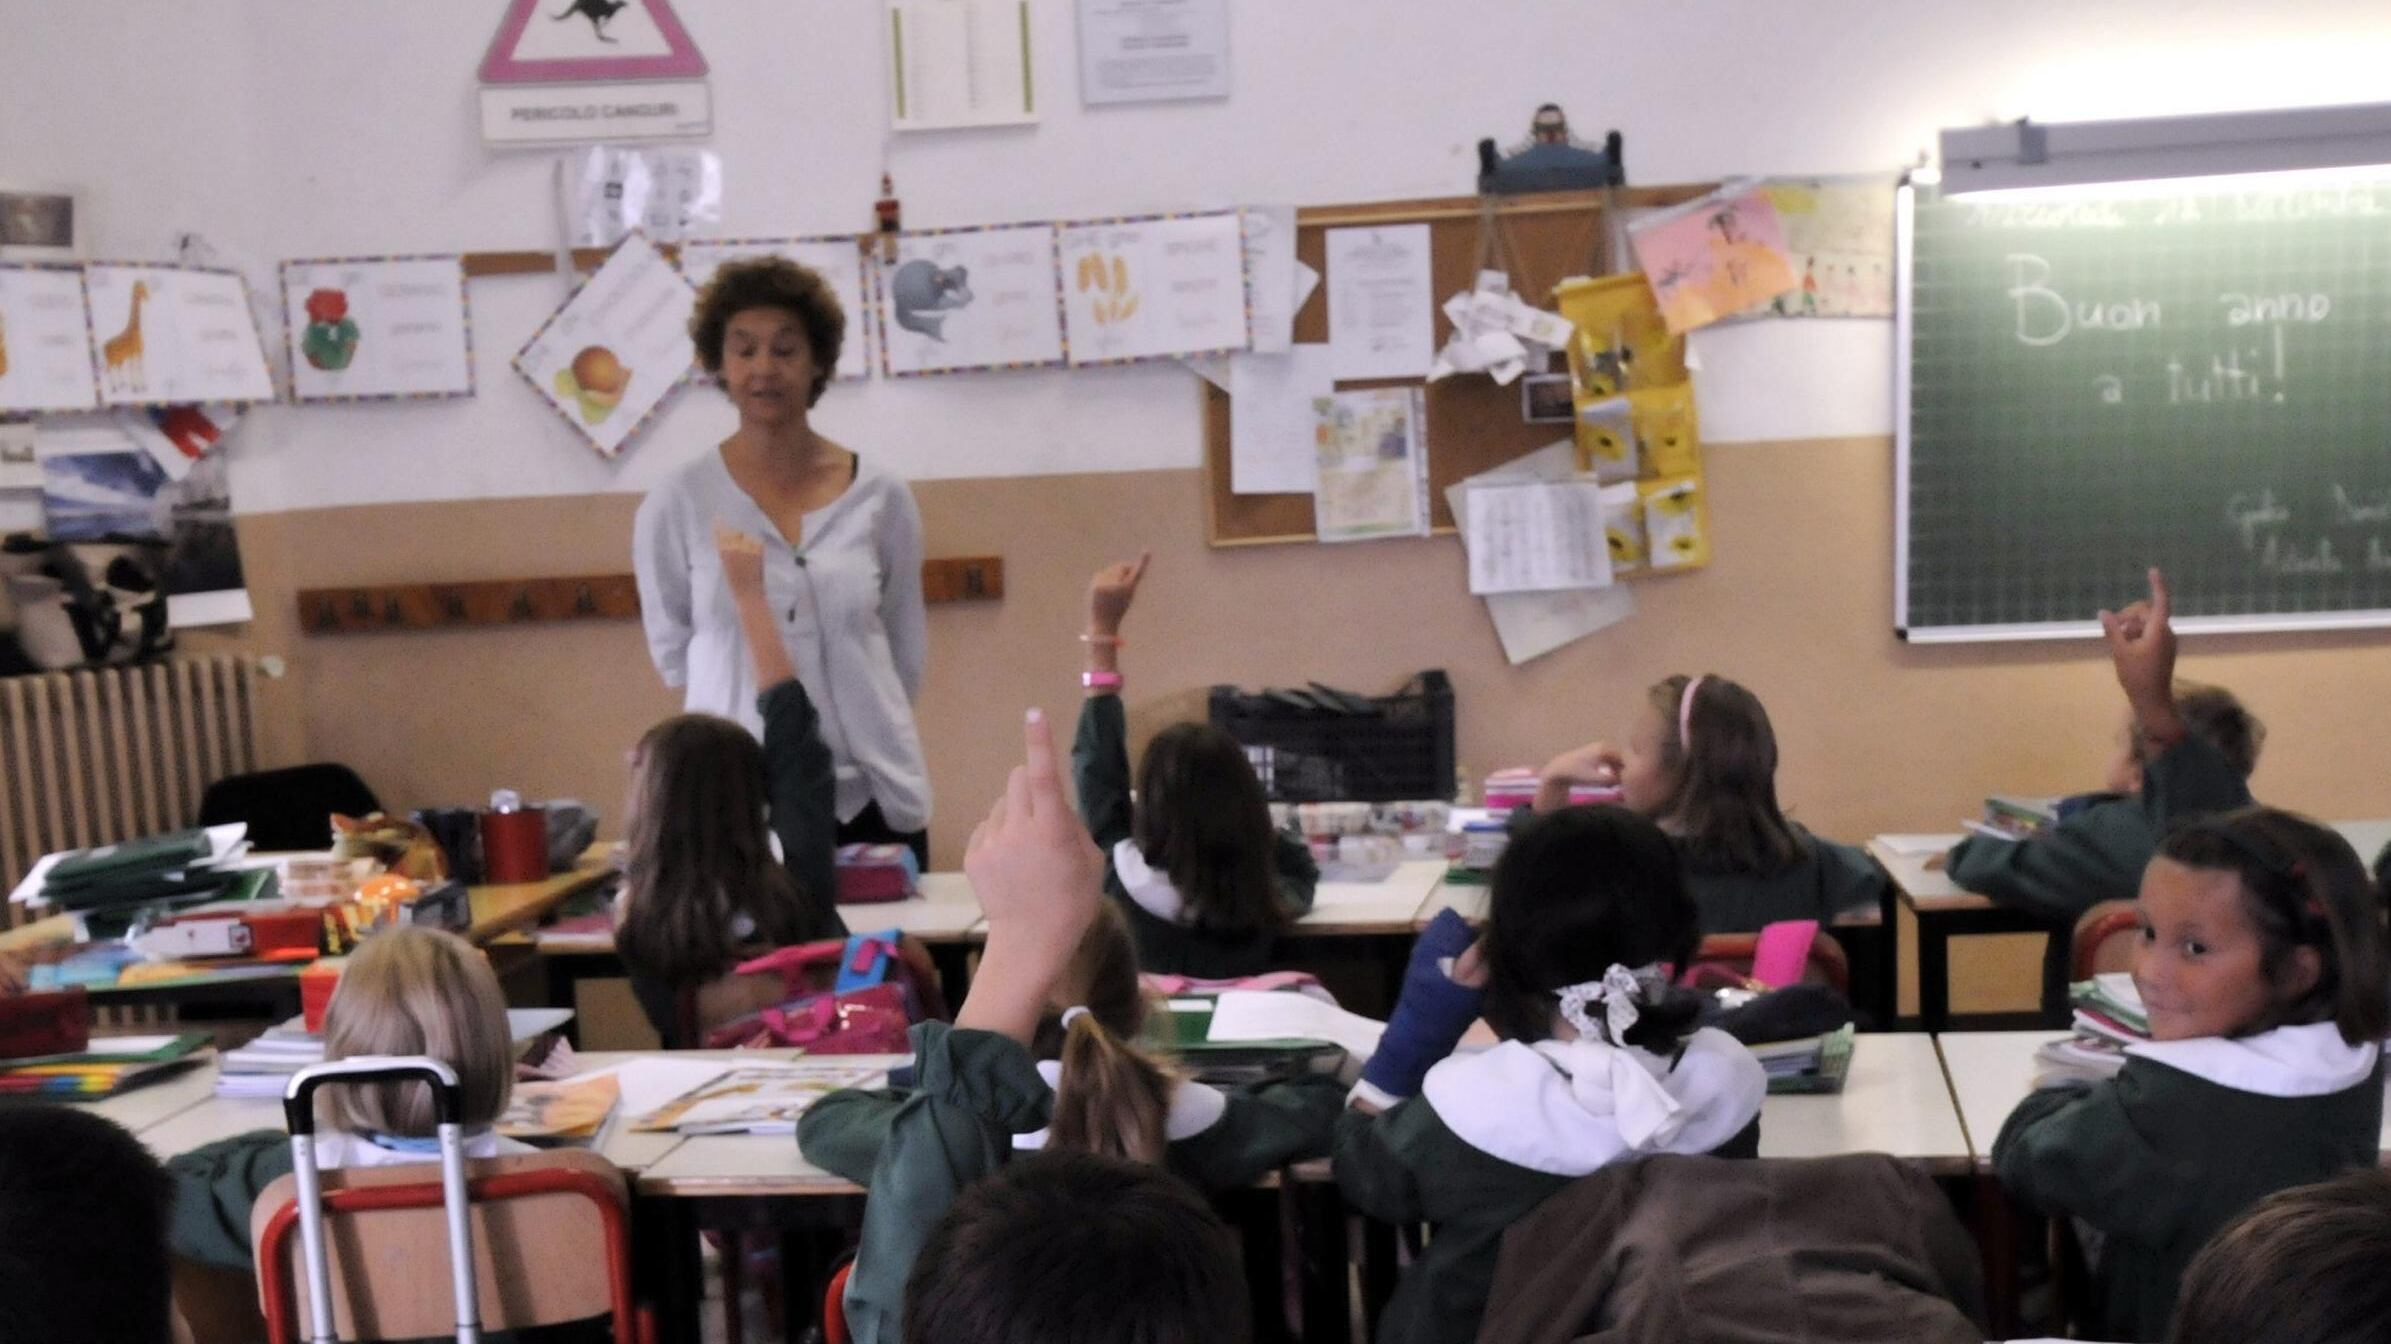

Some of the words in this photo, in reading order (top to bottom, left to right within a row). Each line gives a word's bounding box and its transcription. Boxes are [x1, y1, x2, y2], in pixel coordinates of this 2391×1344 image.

[510, 104, 598, 121] PERICOLO
[2004, 252, 2161, 346] Buon
[2219, 293, 2331, 327] anno
[2099, 373, 2123, 403] a
